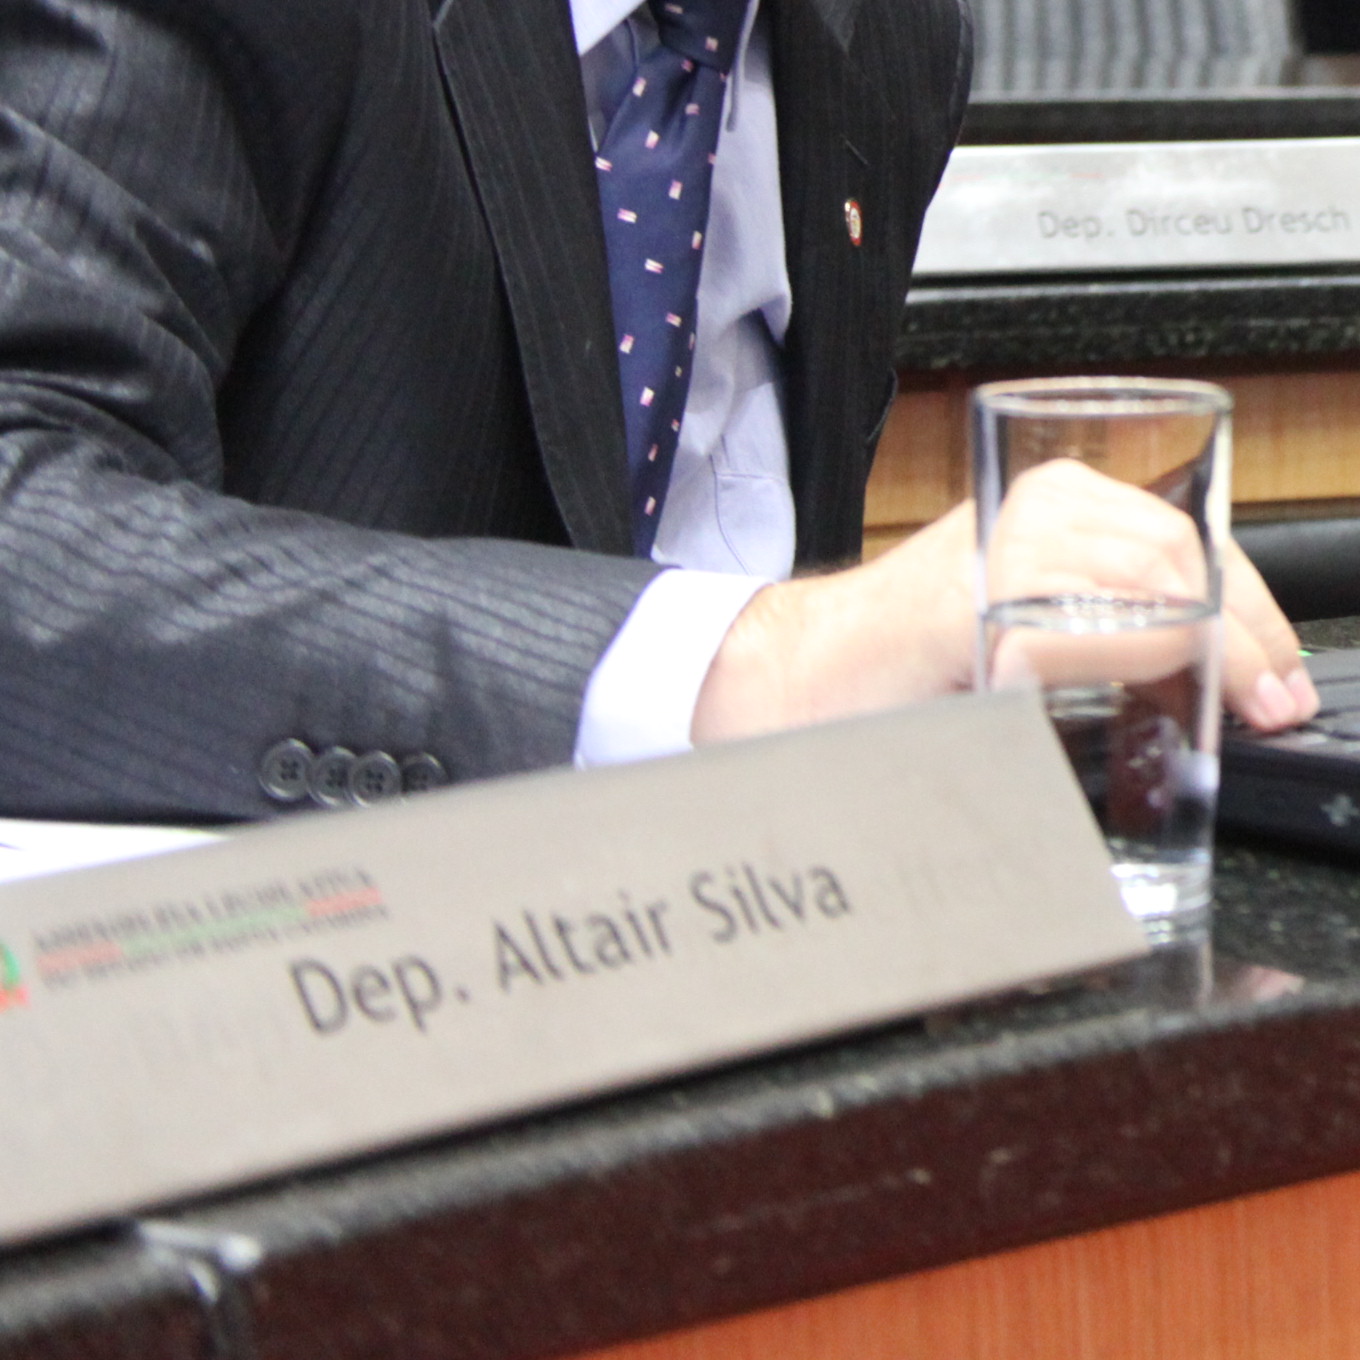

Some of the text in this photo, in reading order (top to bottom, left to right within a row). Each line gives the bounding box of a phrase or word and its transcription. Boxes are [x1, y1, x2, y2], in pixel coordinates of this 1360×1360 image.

[1036, 205, 1351, 240] Dep. Dirceu Dresch
[288, 861, 853, 1037] Dep. Altair Silva
